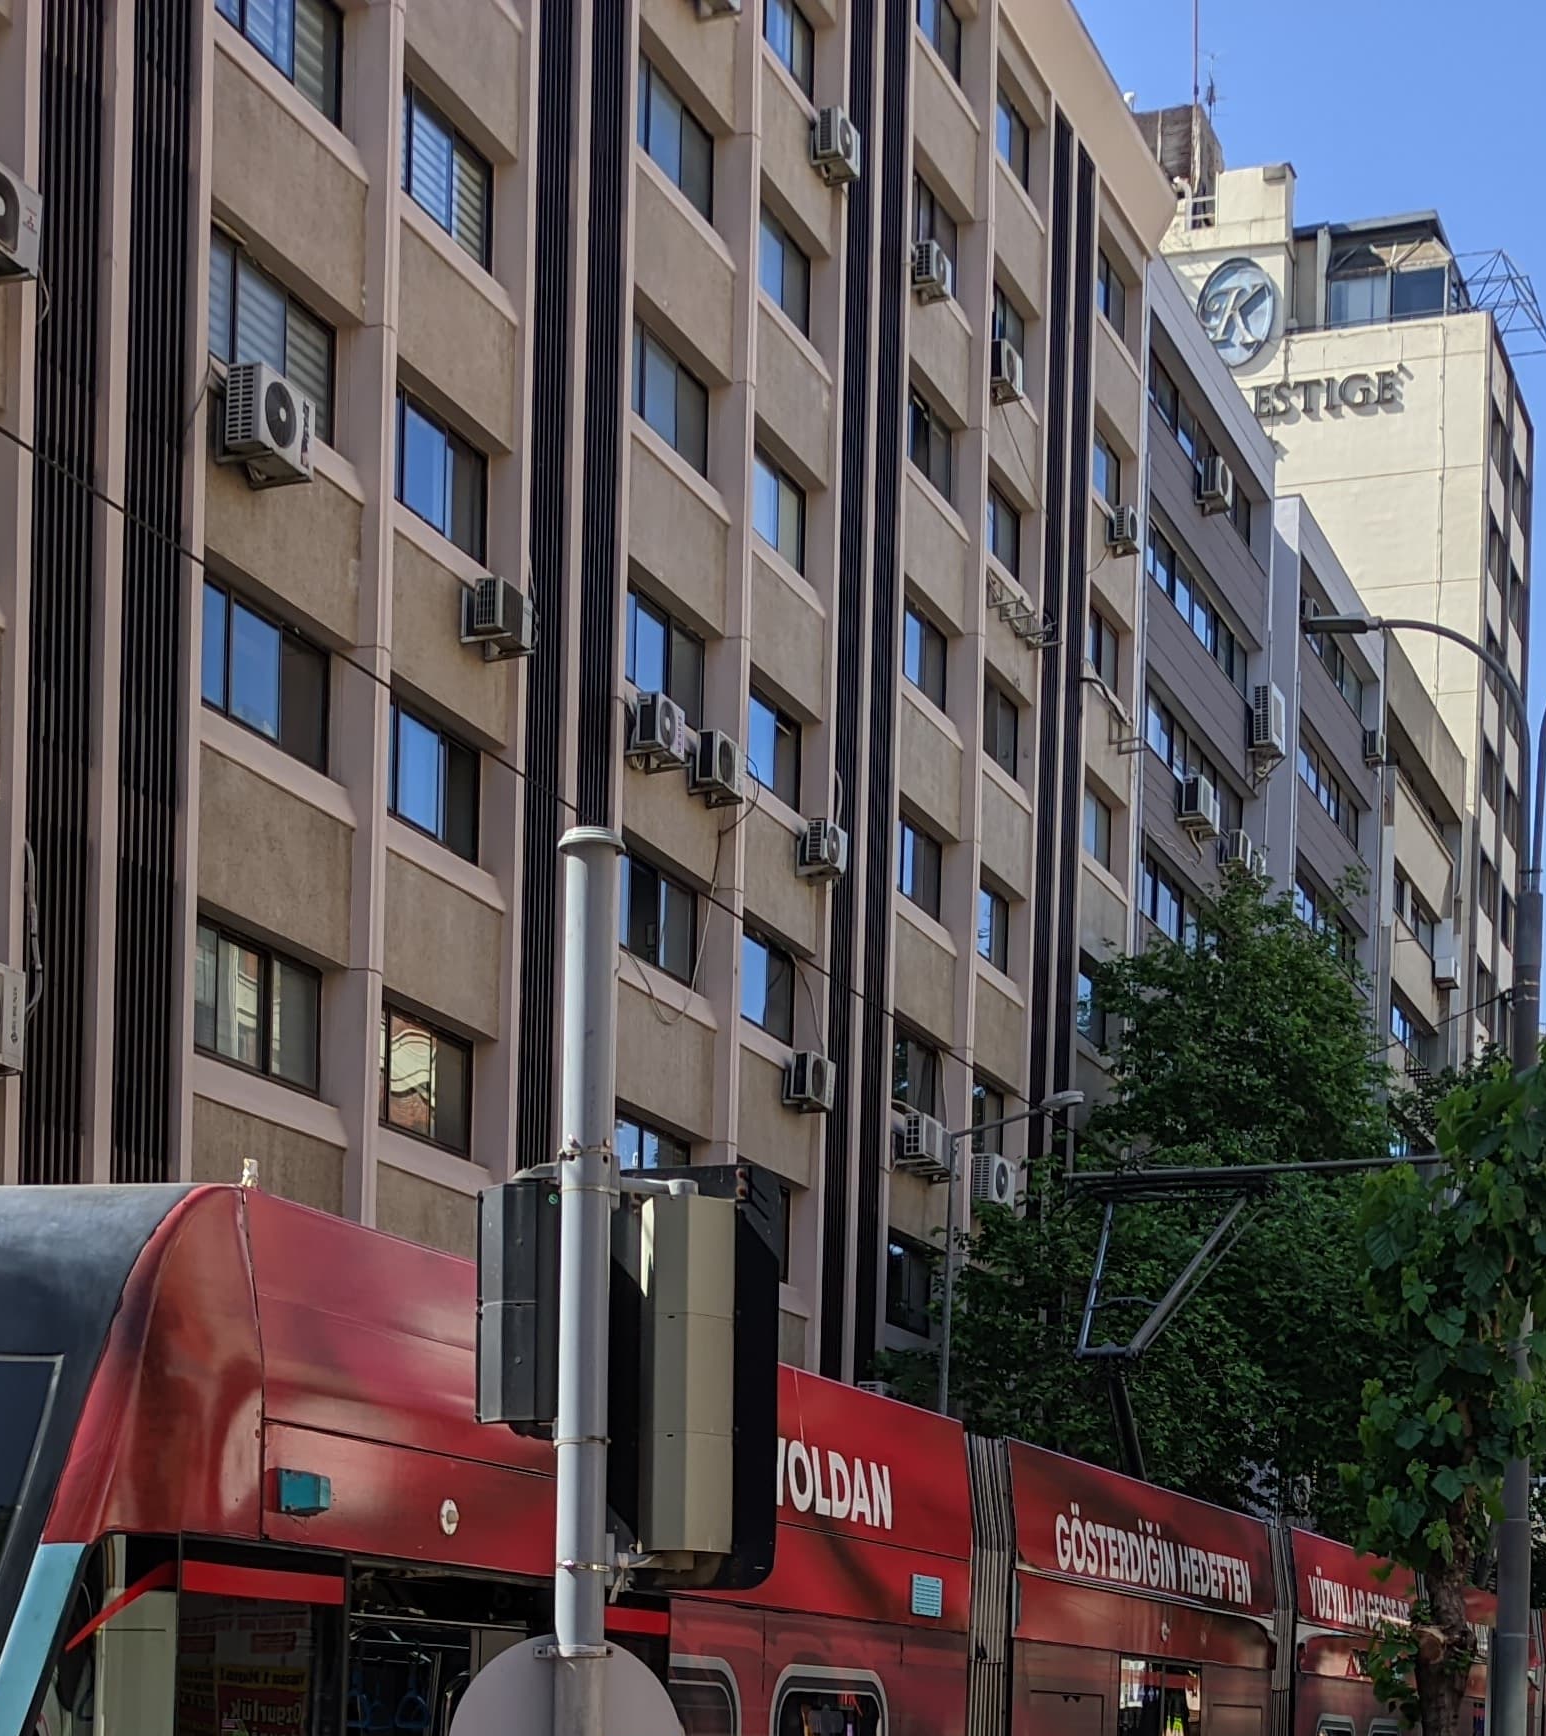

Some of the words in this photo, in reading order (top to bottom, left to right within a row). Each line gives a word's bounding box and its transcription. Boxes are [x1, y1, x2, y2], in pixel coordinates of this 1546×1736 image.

[1254, 370, 1394, 417] ESTIGE
[1055, 1501, 1177, 1591] GÖSTERDİĞİN
[1177, 1543, 1252, 1605] HEDEFTEN
